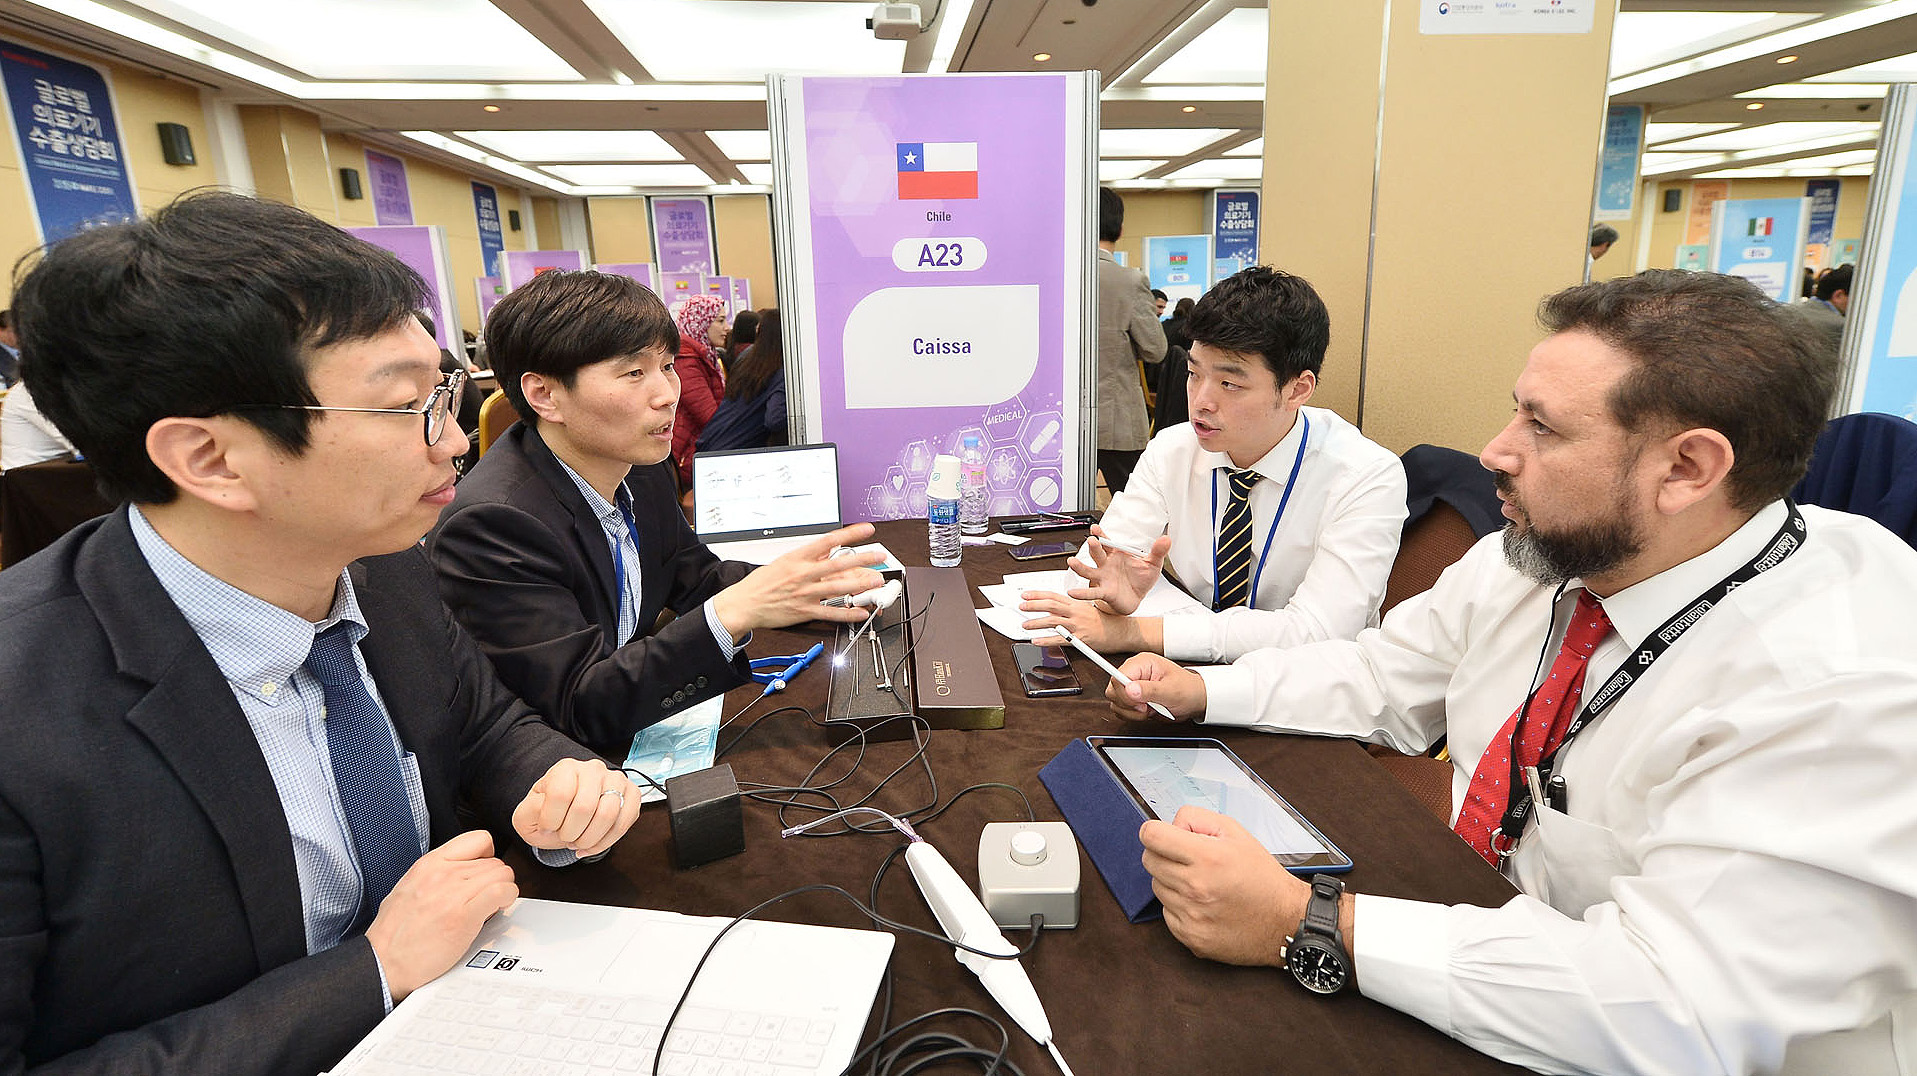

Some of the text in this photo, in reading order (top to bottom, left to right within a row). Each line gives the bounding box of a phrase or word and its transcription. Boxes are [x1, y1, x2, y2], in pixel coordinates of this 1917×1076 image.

[34, 78, 92, 114] 글로벌
[32, 104, 103, 138] 의료기기
[28, 126, 118, 162] 수출상담회
[926, 211, 952, 222] Chile
[917, 243, 963, 267] A23
[912, 338, 972, 355] Caissa
[987, 410, 1023, 426] MEDICAL
[1757, 535, 1797, 572] Colantotte
[1661, 601, 1711, 642] Colantotte
[1590, 673, 1631, 711] Colantotte
